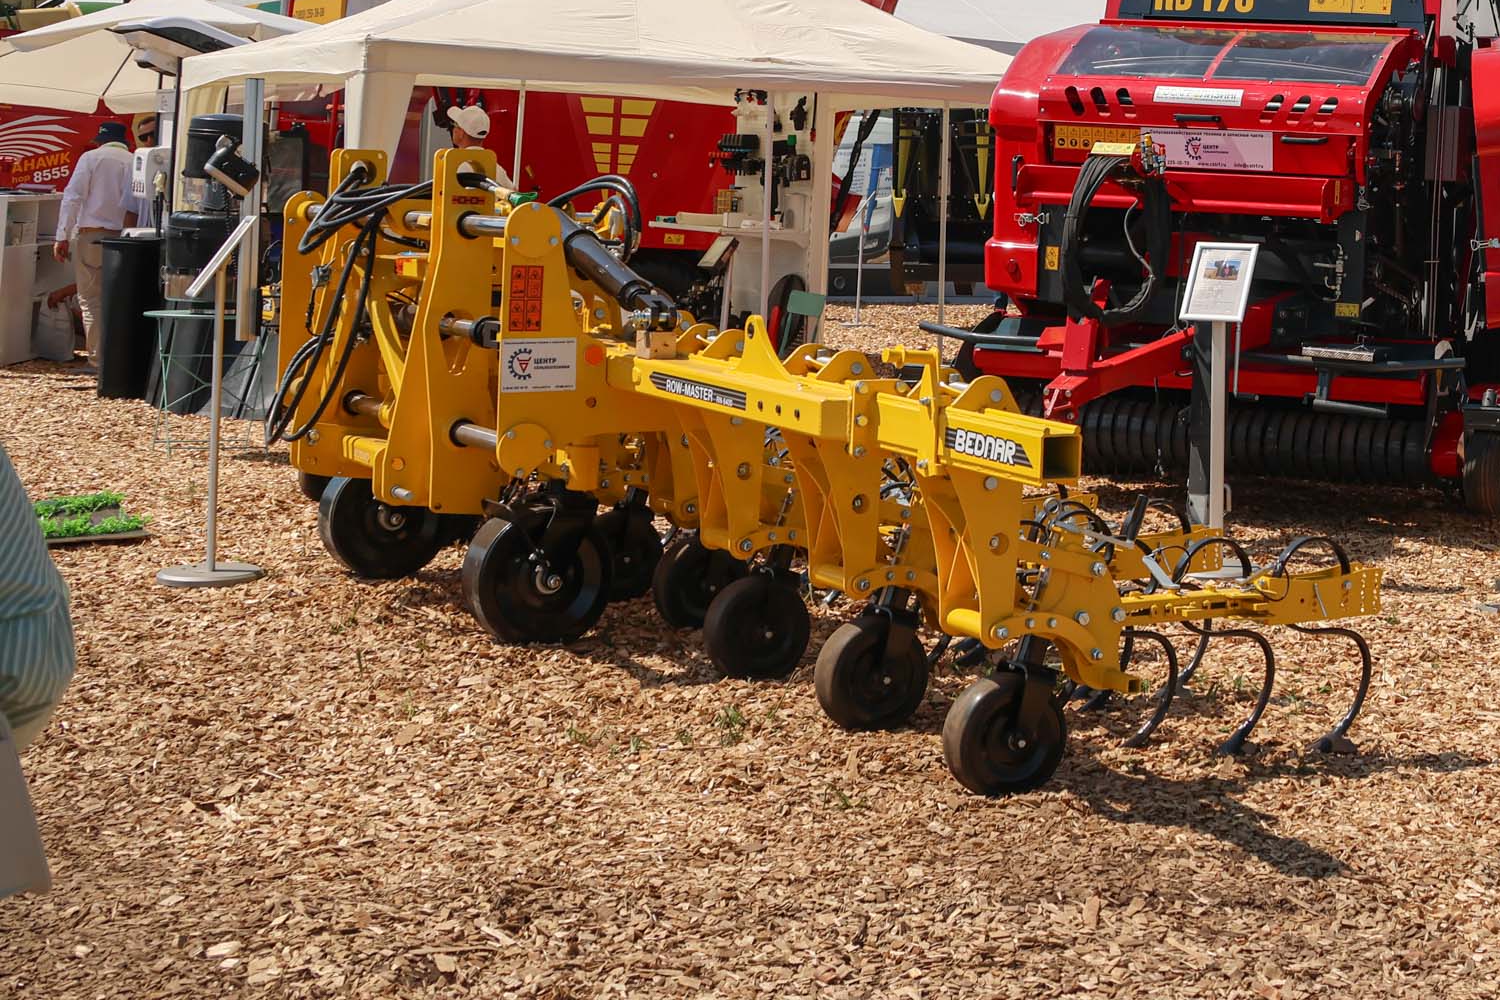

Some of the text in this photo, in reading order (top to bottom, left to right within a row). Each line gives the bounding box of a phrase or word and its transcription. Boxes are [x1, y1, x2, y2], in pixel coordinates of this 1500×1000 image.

[12, 151, 71, 173] AHAWK
[33, 165, 70, 183] 8555
[666, 379, 714, 402] ROW-MASTER
[954, 429, 1017, 465] BEDNAR
